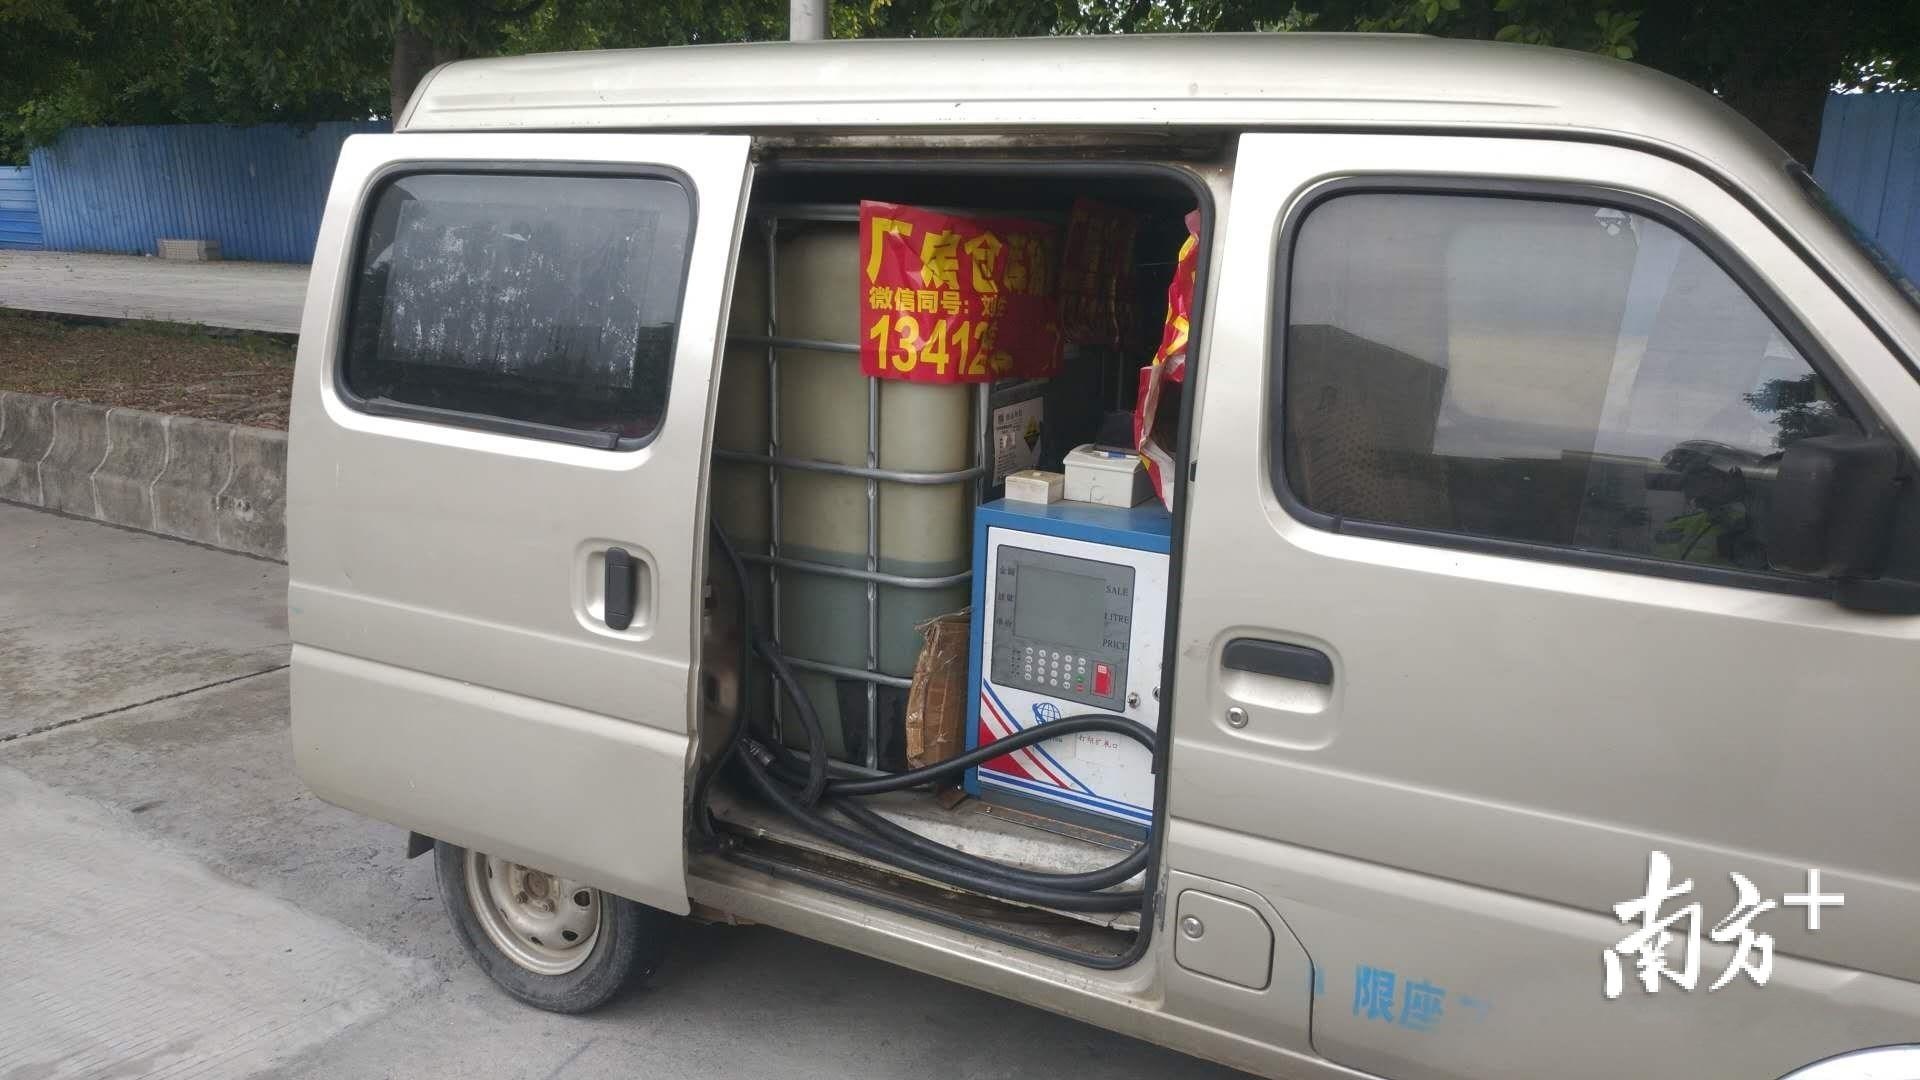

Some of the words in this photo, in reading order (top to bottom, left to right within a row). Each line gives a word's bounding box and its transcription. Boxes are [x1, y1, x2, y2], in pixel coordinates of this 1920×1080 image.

[870, 315, 1012, 376] 13412
[1105, 584, 1129, 597] SALE
[1104, 611, 1129, 625] LITRE
[1353, 964, 1491, 1033] 限座
